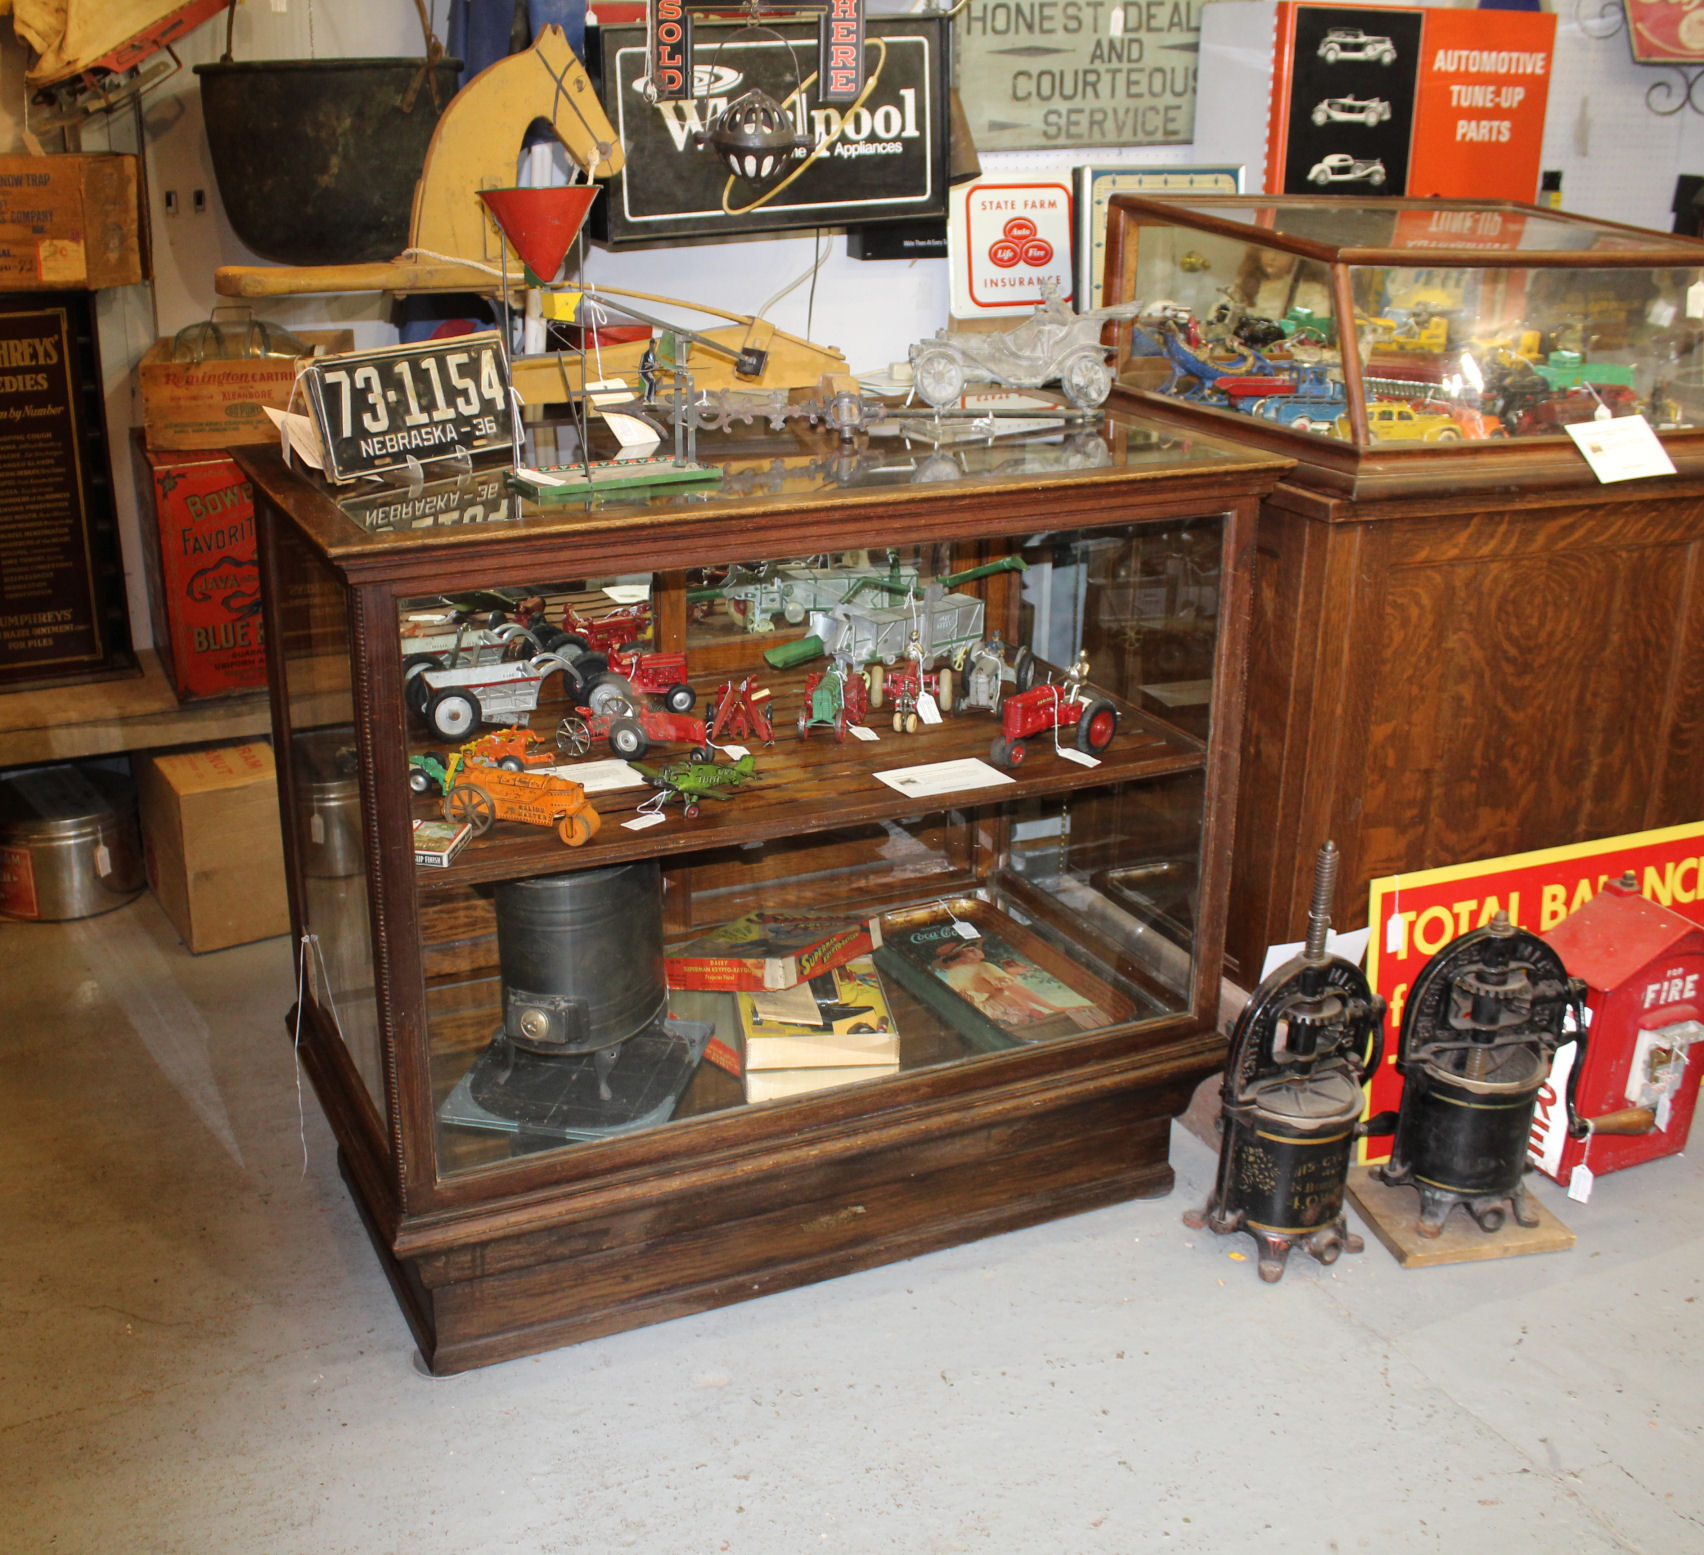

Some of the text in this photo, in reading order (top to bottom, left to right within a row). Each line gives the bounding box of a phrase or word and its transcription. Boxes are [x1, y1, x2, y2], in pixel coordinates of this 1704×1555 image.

[966, 2, 1104, 35] HONEST
[658, 0, 683, 91] SOLD
[830, 0, 857, 92] HERE
[1090, 37, 1143, 65] AND
[1433, 49, 1547, 75] AUTOMOTIVE
[1450, 85, 1525, 108] TUNE-UP
[1042, 105, 1182, 140] SERVICE
[1456, 120, 1511, 142] PARTS
[835, 141, 903, 160] Appliances
[10, 210, 54, 223] COMPANY
[981, 199, 1058, 211] STATE FARM
[1011, 226, 1031, 236] Auto
[997, 248, 1045, 259] Life Fire
[166, 371, 249, 387] Remington
[24, 404, 64, 417] Number
[360, 424, 458, 458] NEBRASKA
[473, 416, 497, 436] 36
[1643, 974, 1699, 1008] FIRE
